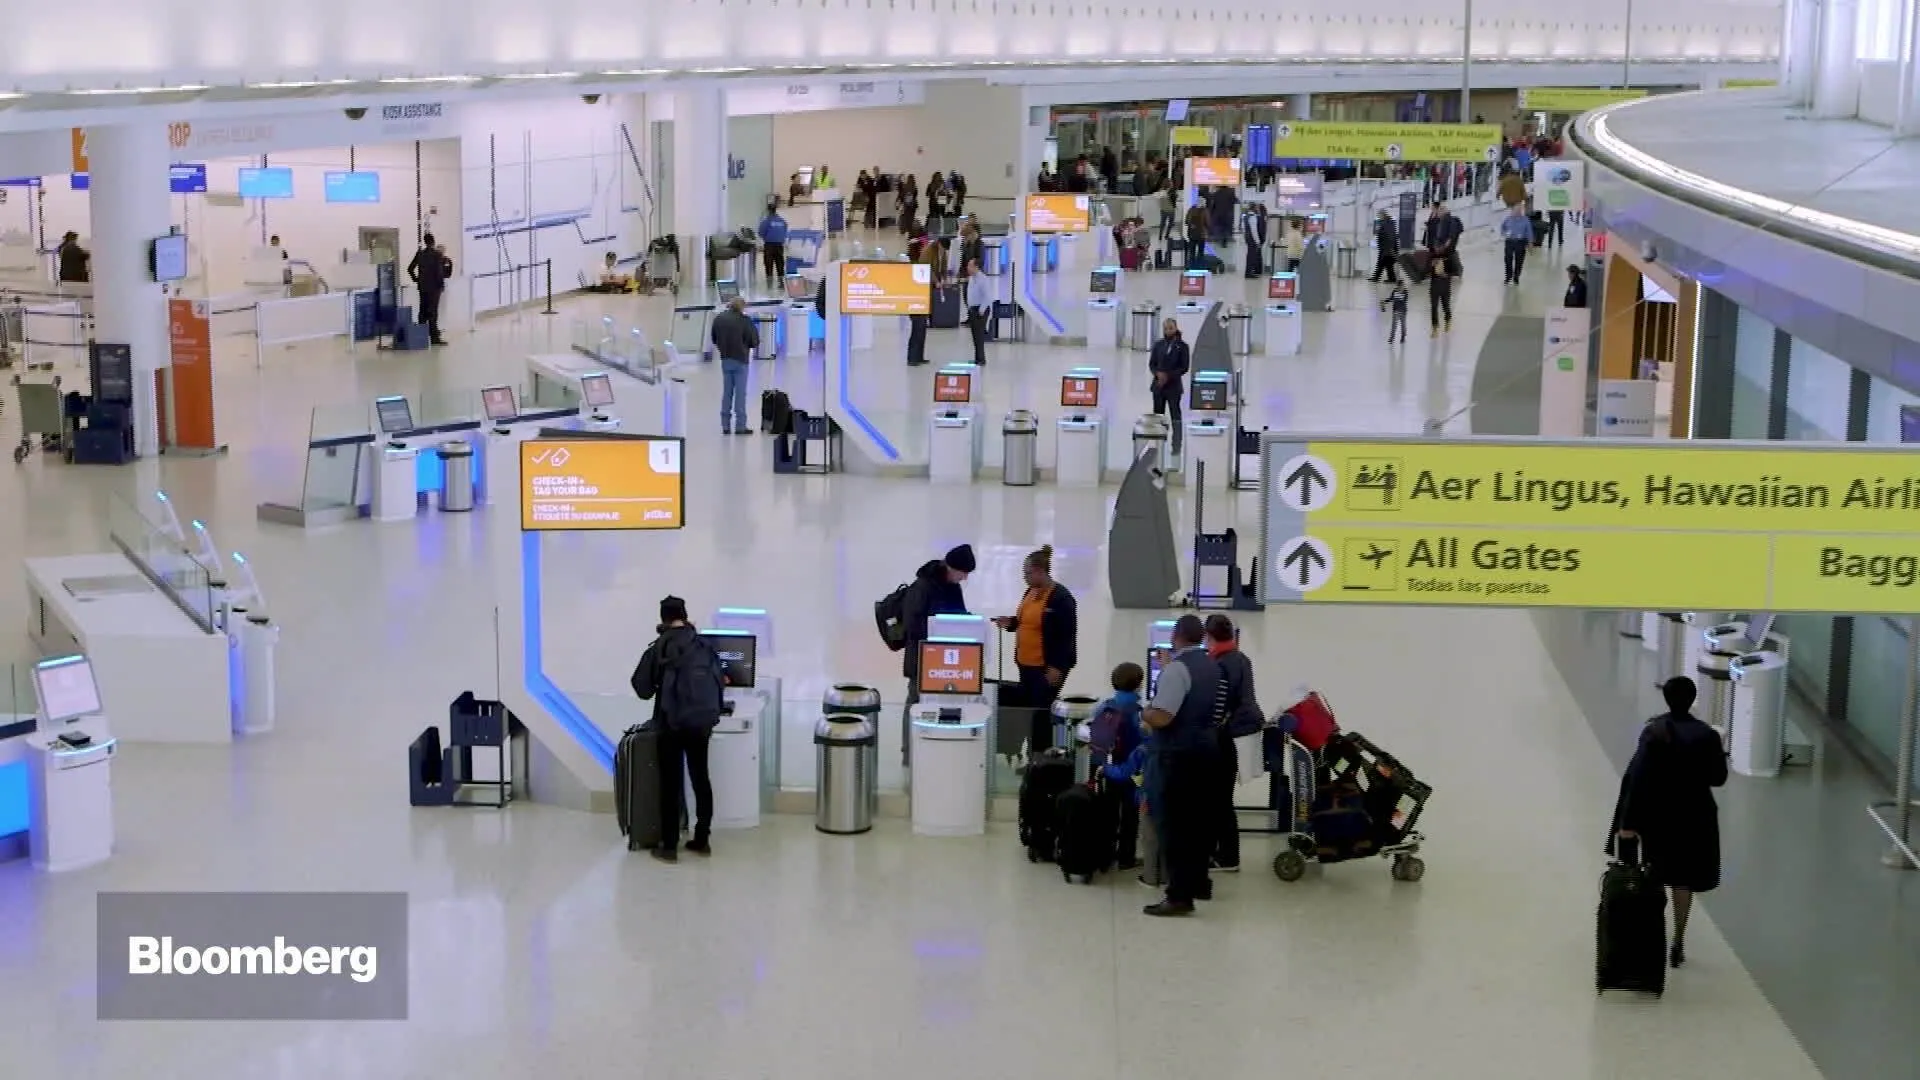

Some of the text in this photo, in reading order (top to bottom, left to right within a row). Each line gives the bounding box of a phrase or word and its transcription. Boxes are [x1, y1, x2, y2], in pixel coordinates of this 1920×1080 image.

[660, 448, 671, 465] 1
[532, 476, 578, 486] CHECK-IN
[553, 486, 577, 496] YOUR
[1409, 470, 1482, 501] Aer
[1493, 470, 1631, 512] Lingus,
[1644, 474, 1830, 508] Hawaiian
[1405, 537, 1582, 572] All Gates
[1819, 546, 1919, 588] Bagg
[1406, 578, 1551, 596] Todas las puertas
[928, 669, 974, 680] CHECK-IN
